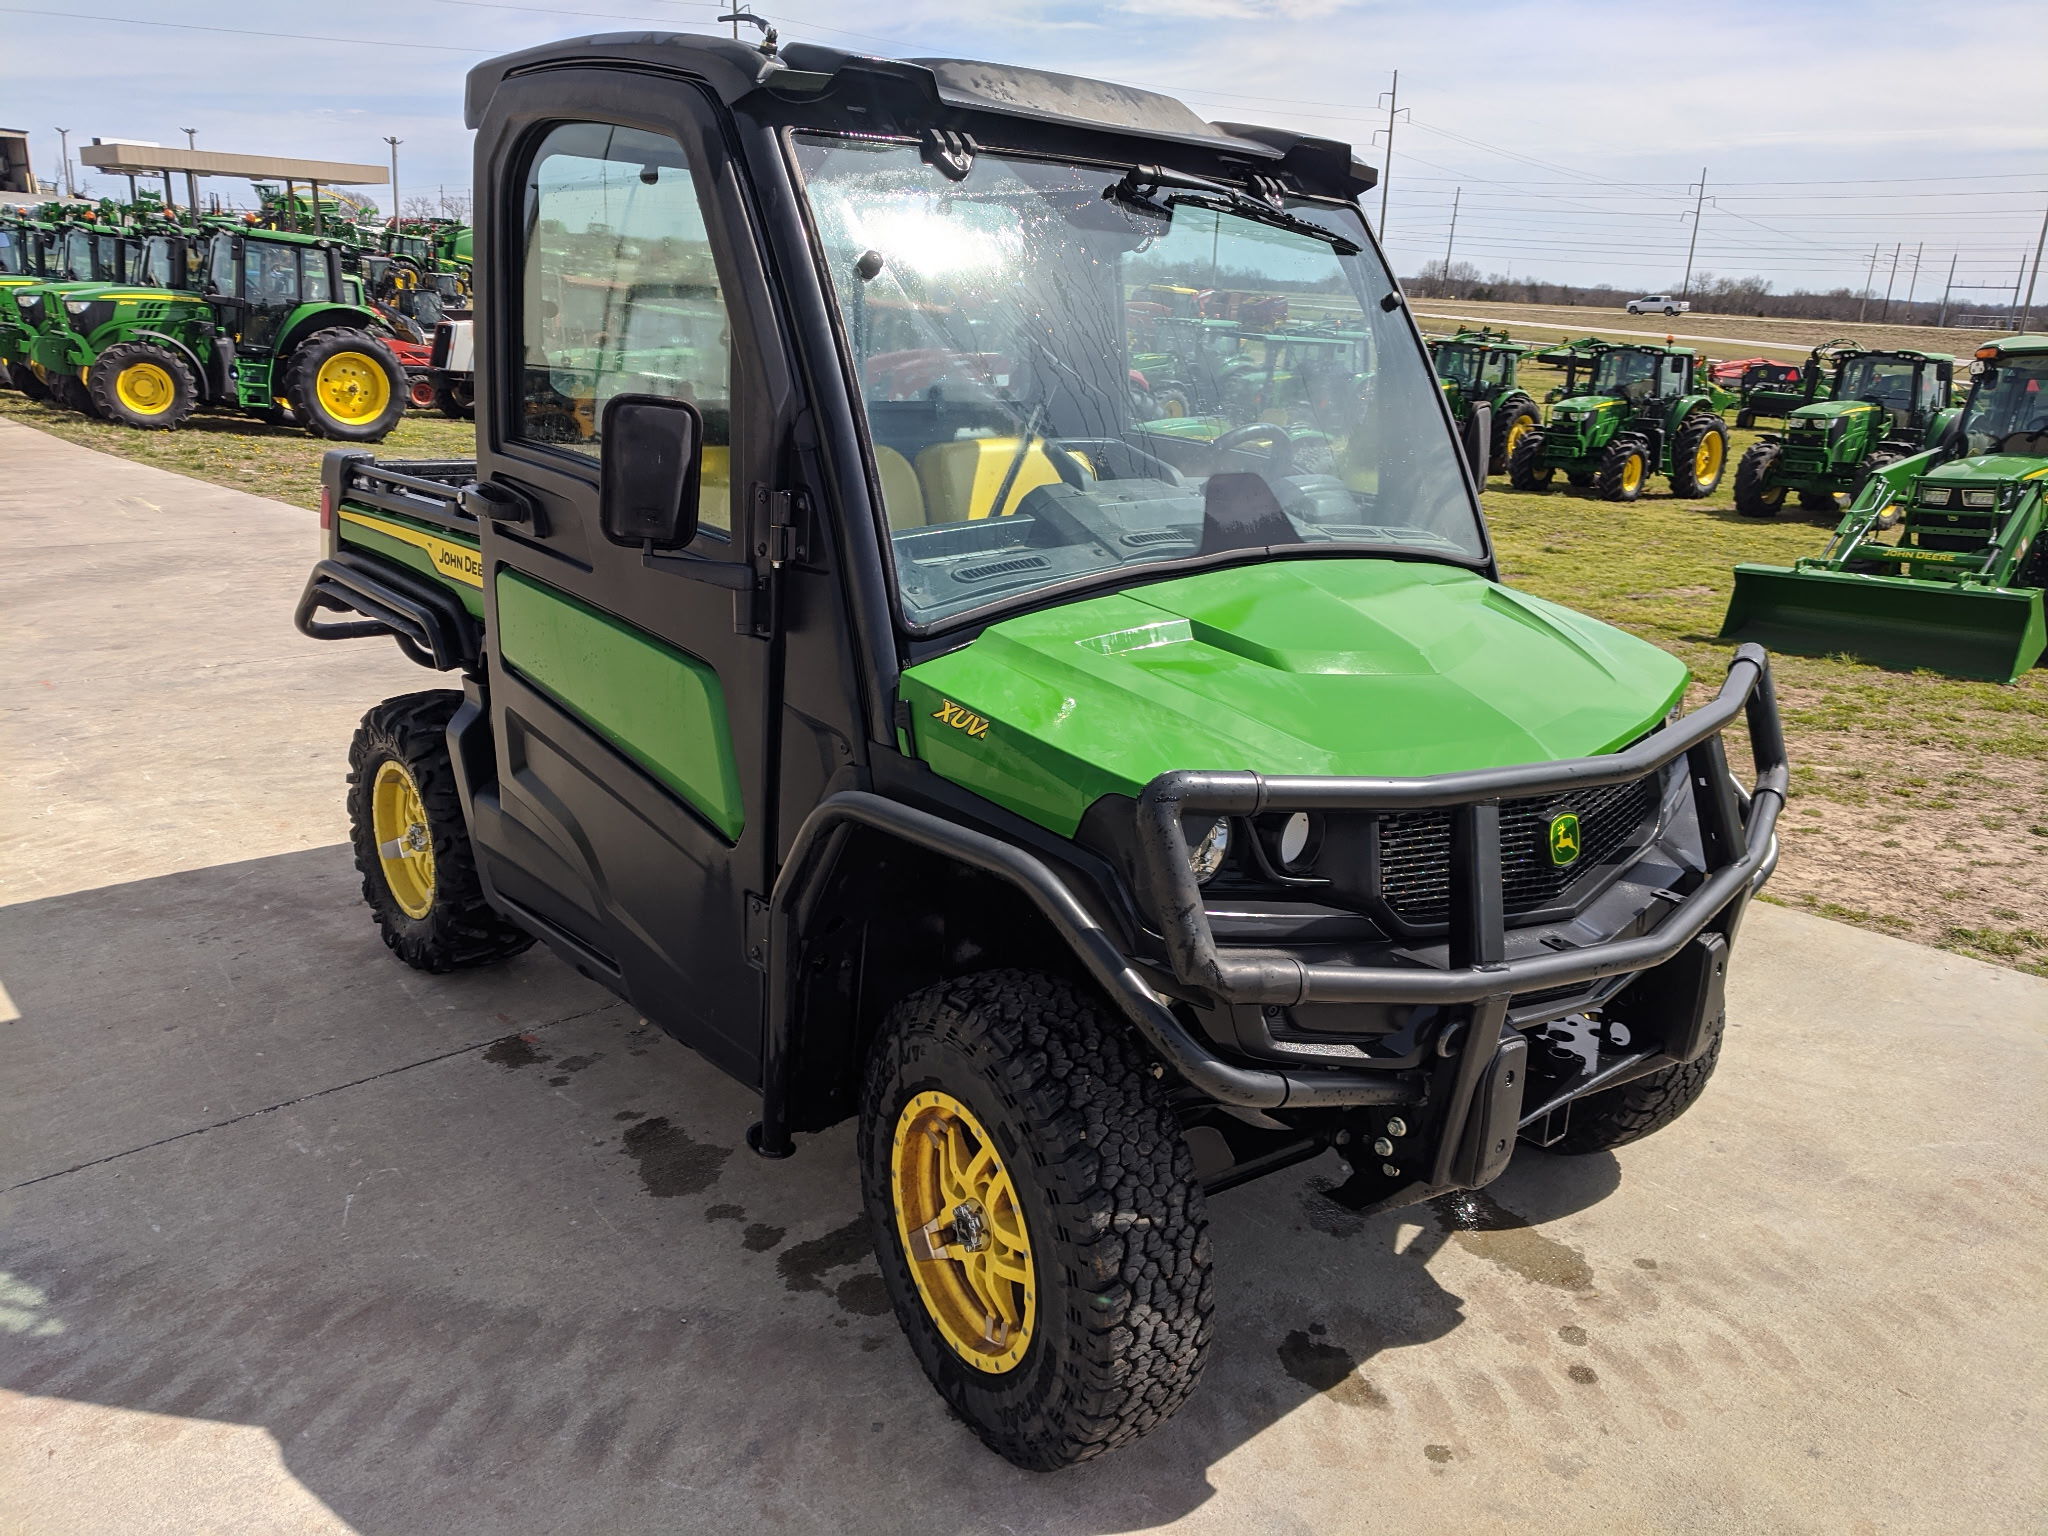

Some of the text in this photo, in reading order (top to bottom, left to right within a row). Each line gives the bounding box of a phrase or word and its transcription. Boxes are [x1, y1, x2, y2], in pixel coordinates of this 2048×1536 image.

[439, 547, 463, 570] JOHN
[1882, 549, 1956, 562] JOHN DEERE
